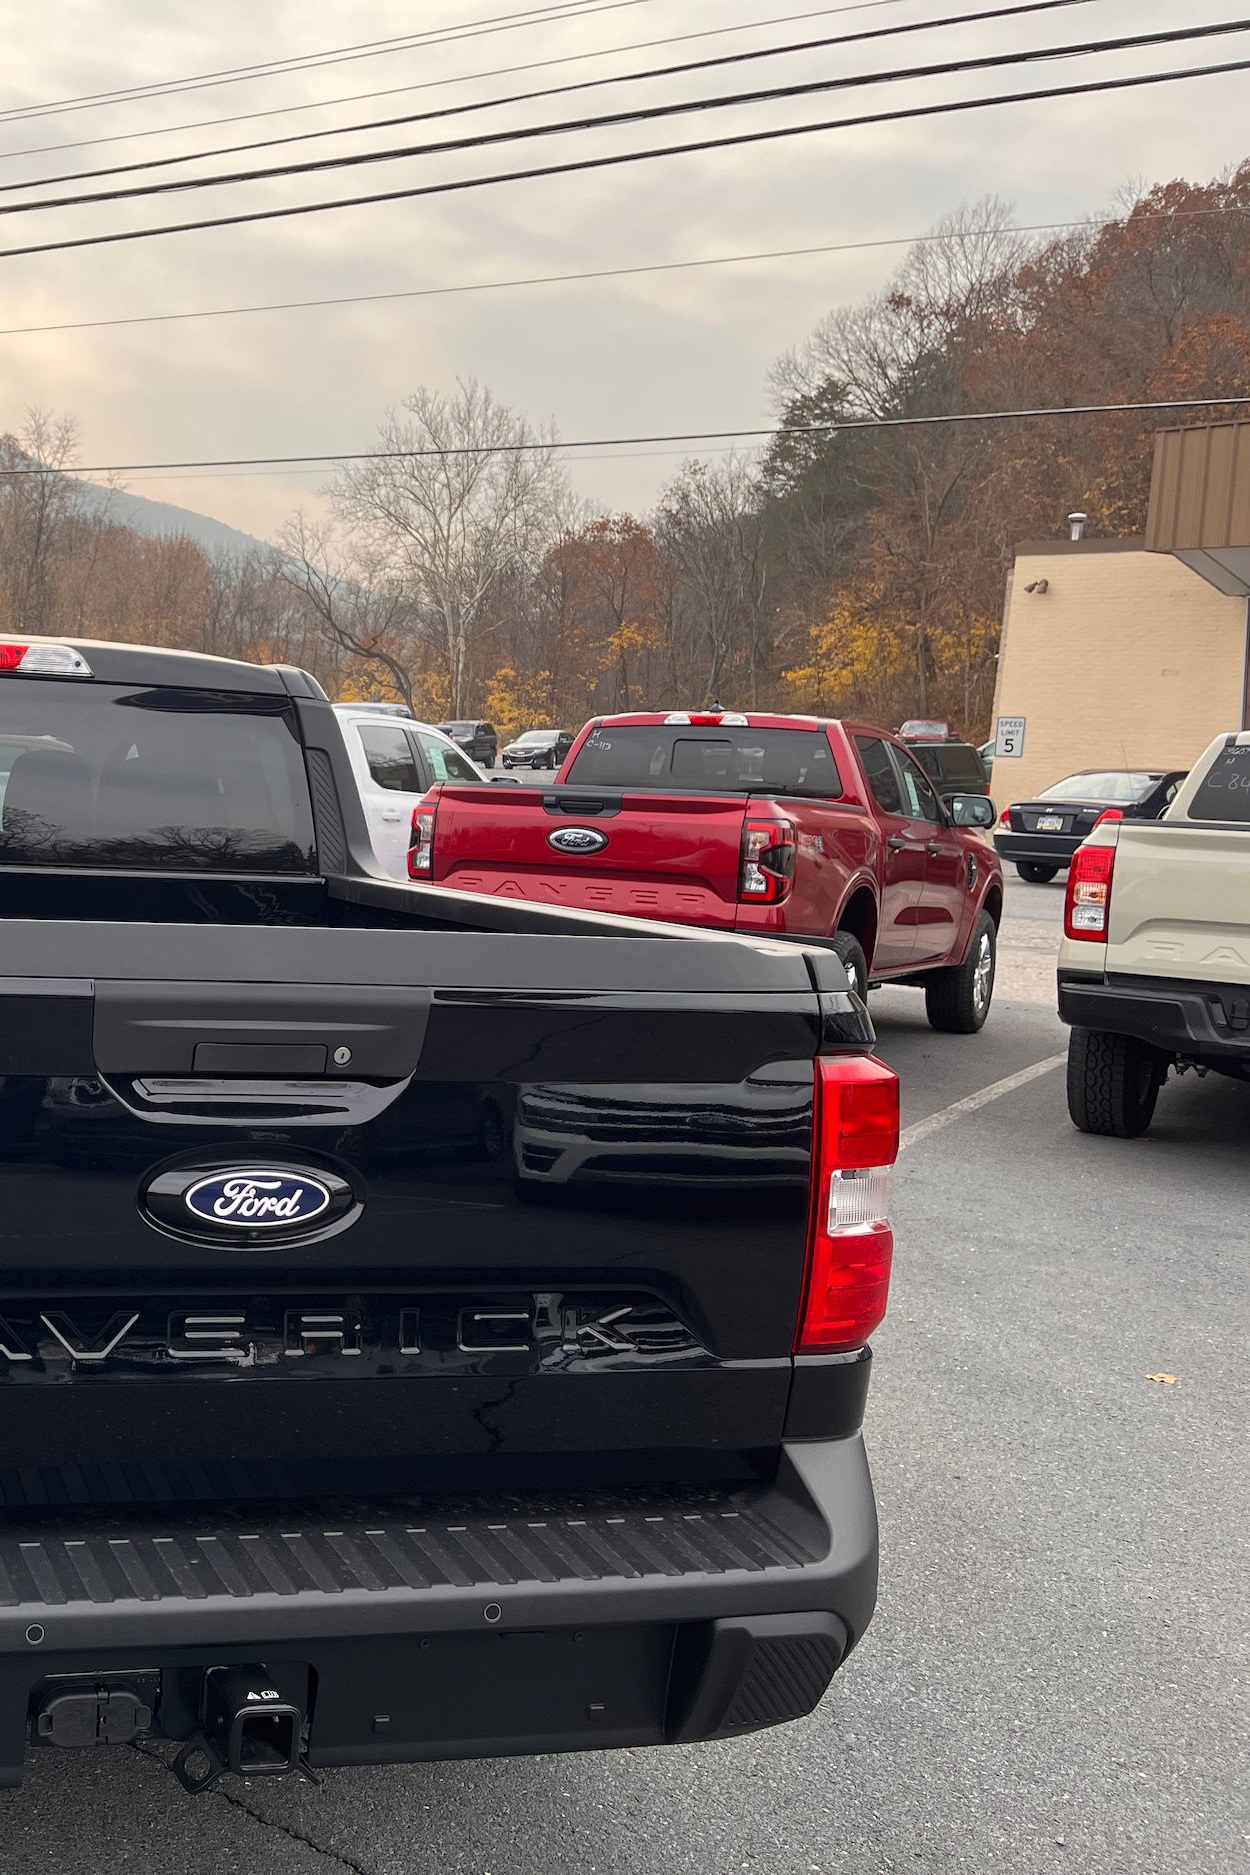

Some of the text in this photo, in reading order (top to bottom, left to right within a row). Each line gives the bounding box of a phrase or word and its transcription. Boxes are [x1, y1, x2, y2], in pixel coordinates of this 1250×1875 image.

[999, 720, 1023, 728] SPEED
[1000, 729, 1020, 737] LIMIT
[1003, 738, 1014, 753] 5
[560, 832, 590, 847] Ford
[457, 876, 707, 912] RANGER
[213, 1178, 304, 1217] Ford
